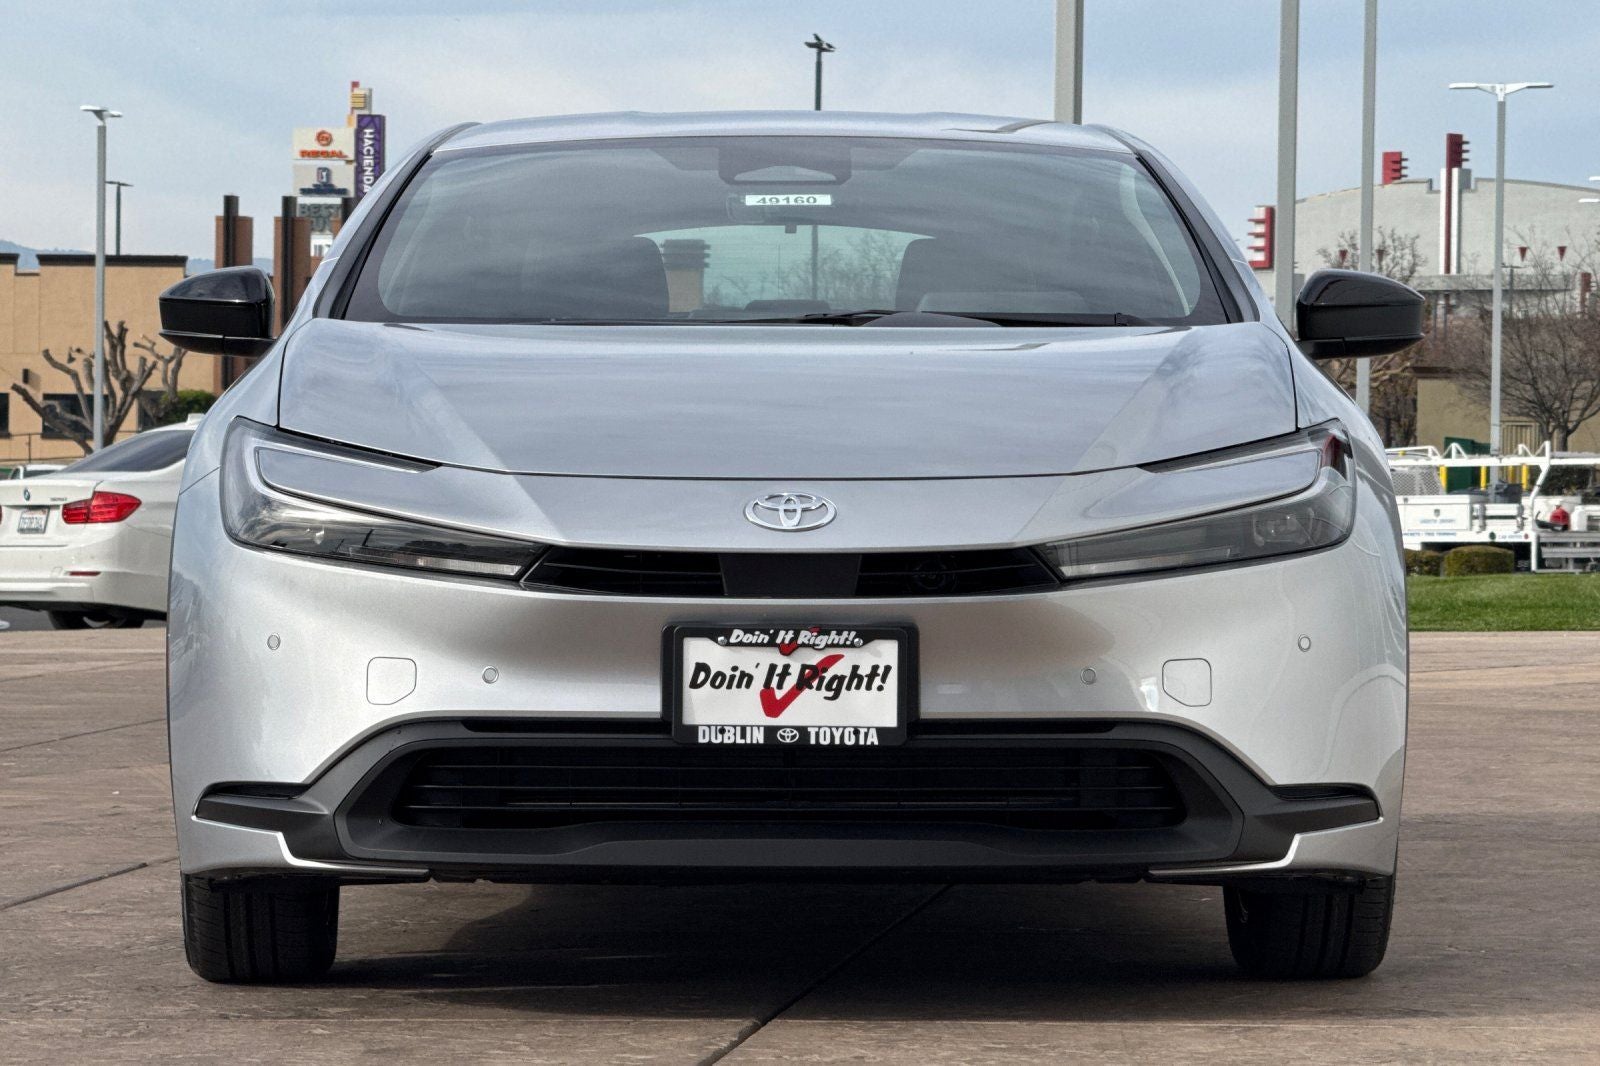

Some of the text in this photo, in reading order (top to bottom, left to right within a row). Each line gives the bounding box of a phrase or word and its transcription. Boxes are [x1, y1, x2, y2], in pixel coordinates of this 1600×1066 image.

[756, 196, 817, 204] 49160
[729, 629, 855, 650] Doin' It Right!
[688, 662, 893, 701] Doin' It Right!
[698, 725, 879, 745] DUBLIN TOYOTA
